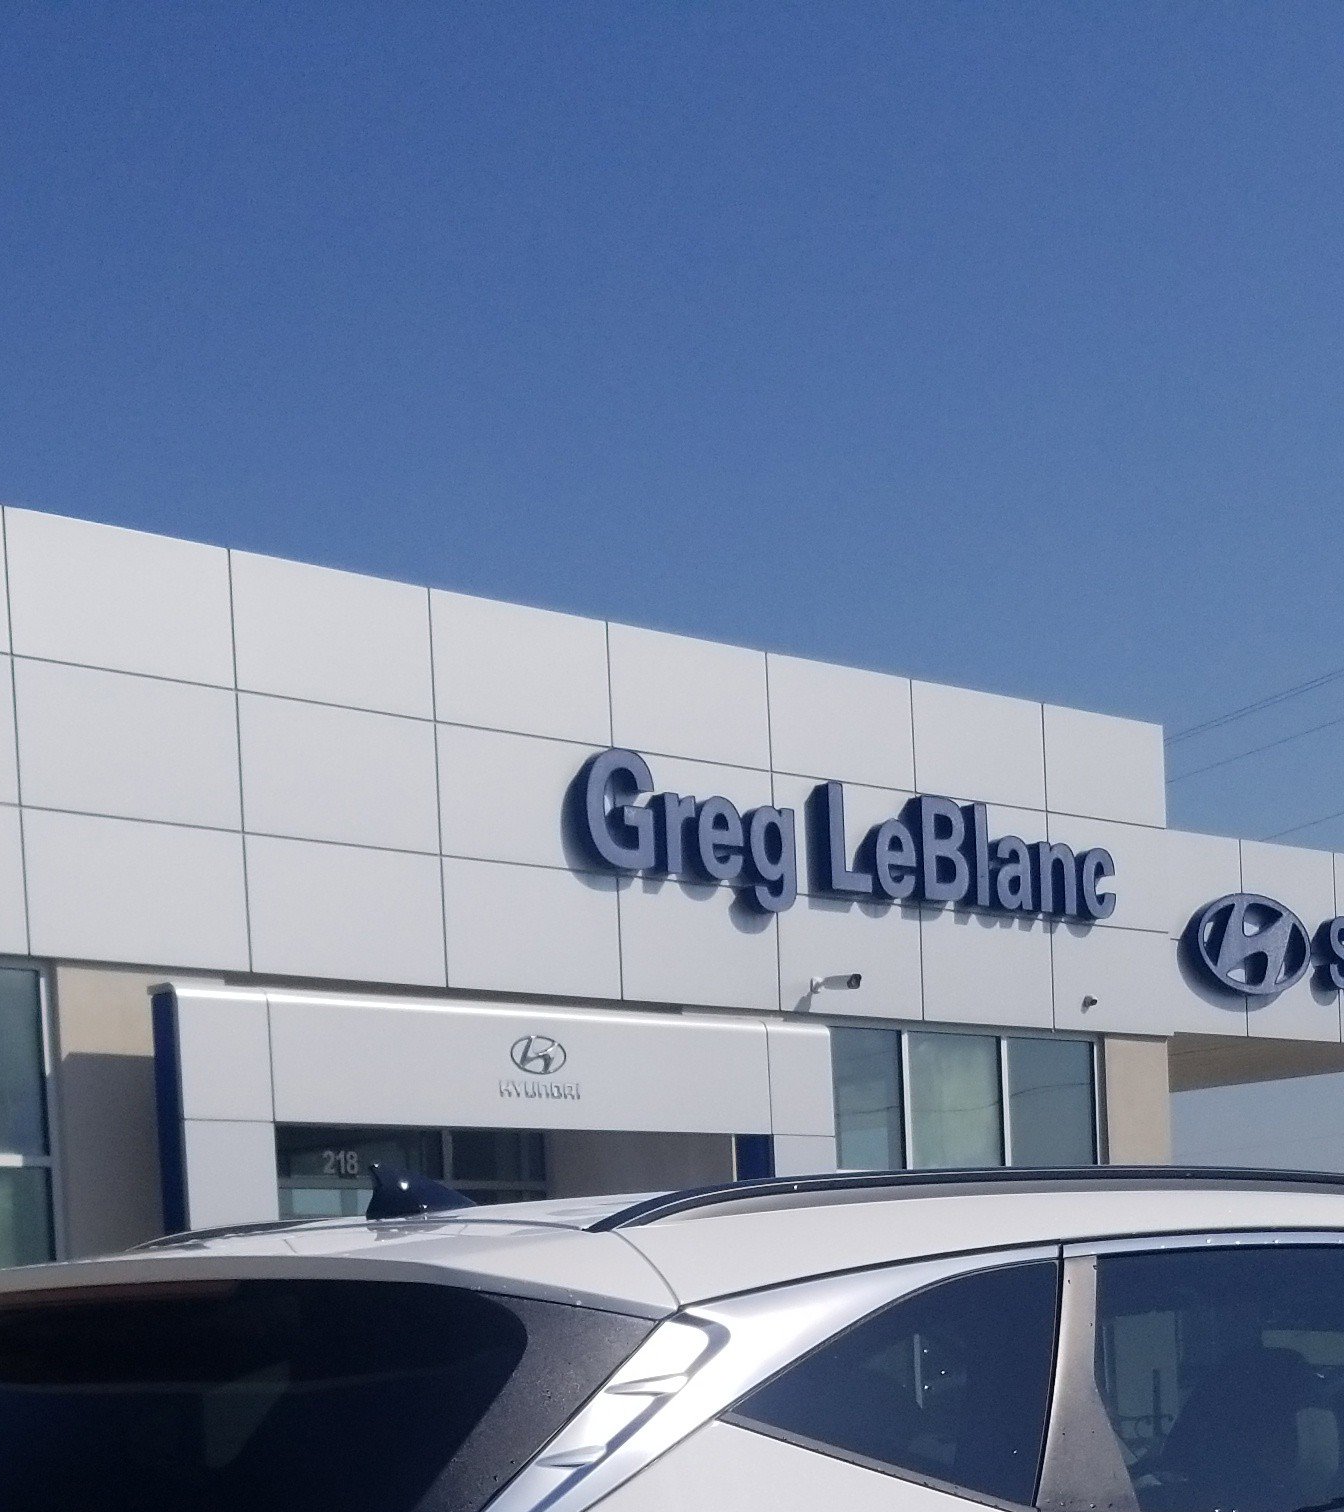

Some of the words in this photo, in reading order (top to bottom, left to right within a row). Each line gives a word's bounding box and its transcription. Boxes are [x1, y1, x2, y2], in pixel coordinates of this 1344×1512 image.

[576, 747, 797, 913] Greg
[812, 781, 1117, 921] LeBlanc
[498, 1079, 582, 1101] HYUNDAI
[323, 1149, 358, 1175] 218
